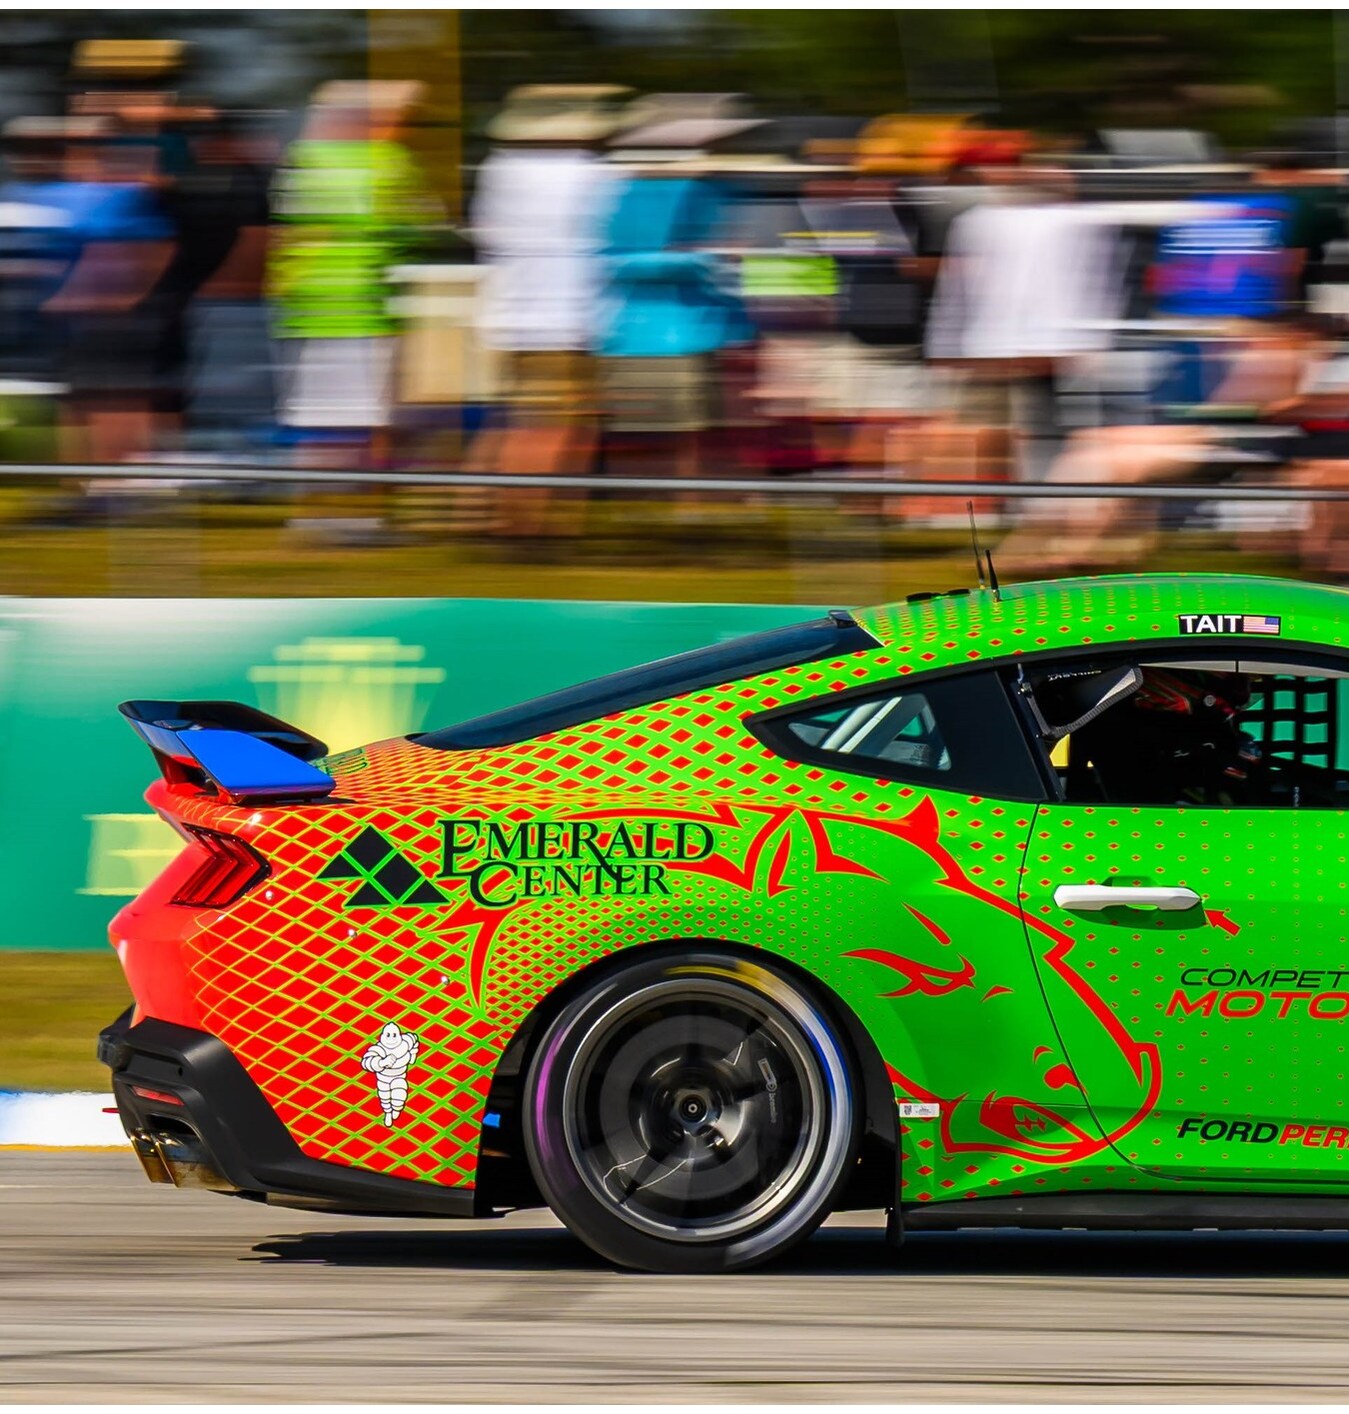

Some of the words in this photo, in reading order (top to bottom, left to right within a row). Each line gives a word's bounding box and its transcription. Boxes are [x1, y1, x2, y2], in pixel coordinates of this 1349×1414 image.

[1180, 615, 1242, 633] TAIT
[437, 819, 714, 880] EMERALD
[470, 860, 672, 907] CENTER
